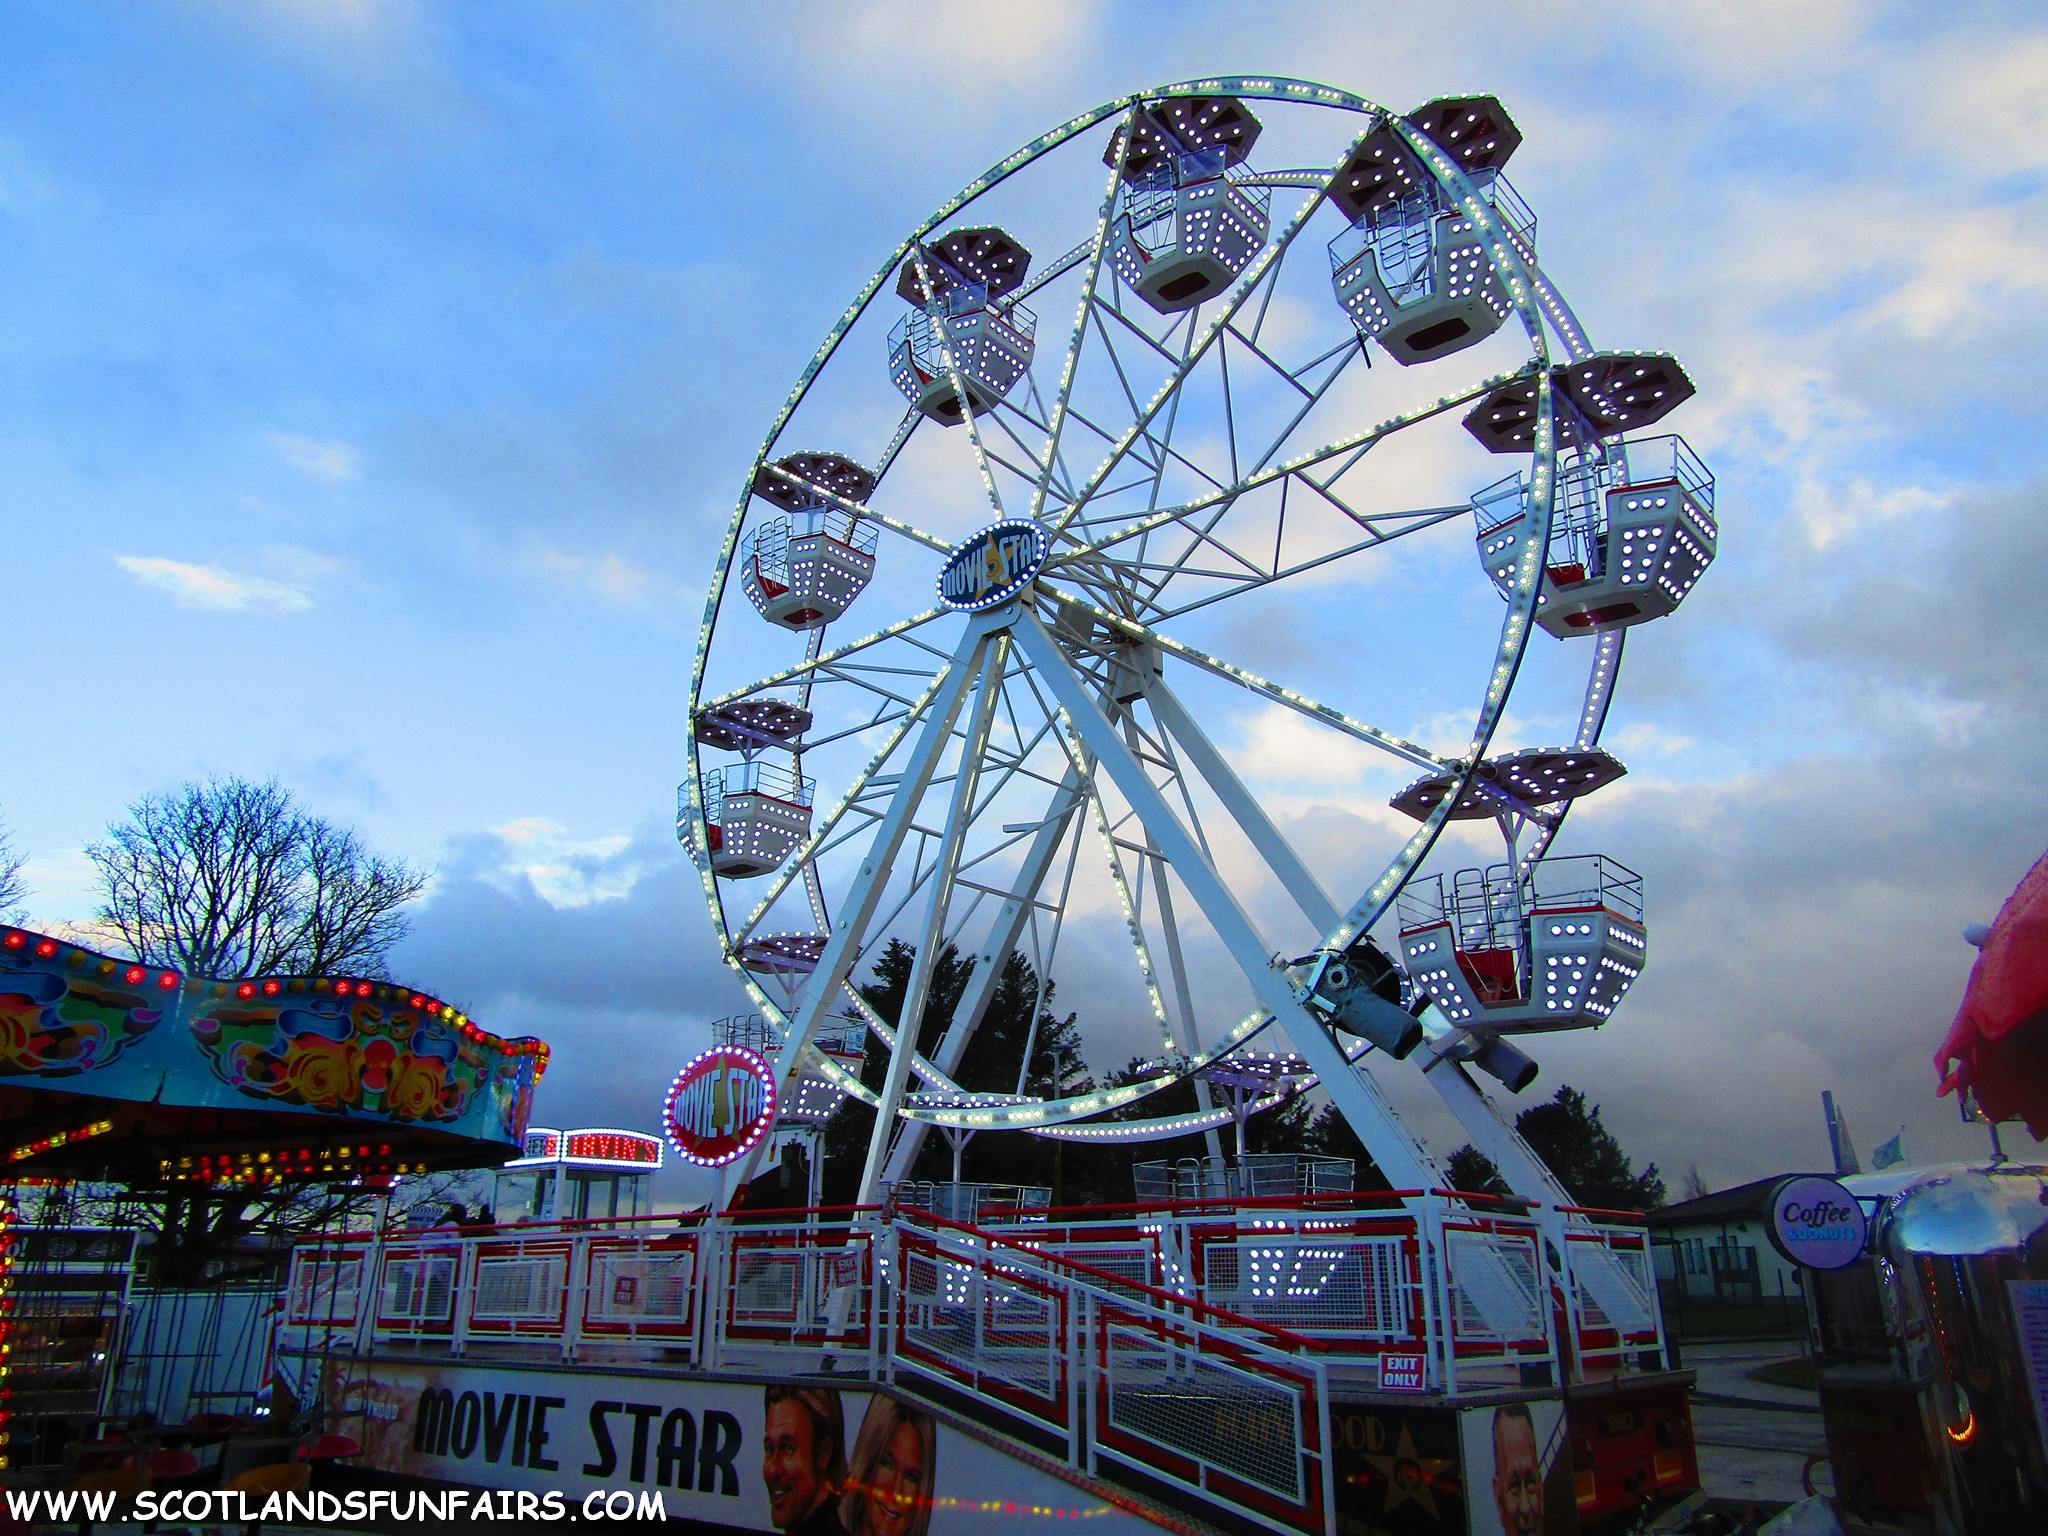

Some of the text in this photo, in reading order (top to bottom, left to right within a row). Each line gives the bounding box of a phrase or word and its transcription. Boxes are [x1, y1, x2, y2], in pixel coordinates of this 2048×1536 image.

[942, 532, 1043, 597] MOVIE STAR
[674, 1067, 768, 1138] MOVIE STAR
[1783, 1201, 1851, 1228] Coffee
[1384, 1373, 1419, 1386] ONLY
[1387, 1357, 1418, 1370] EXIT
[413, 1387, 742, 1497] MOVIE STAR
